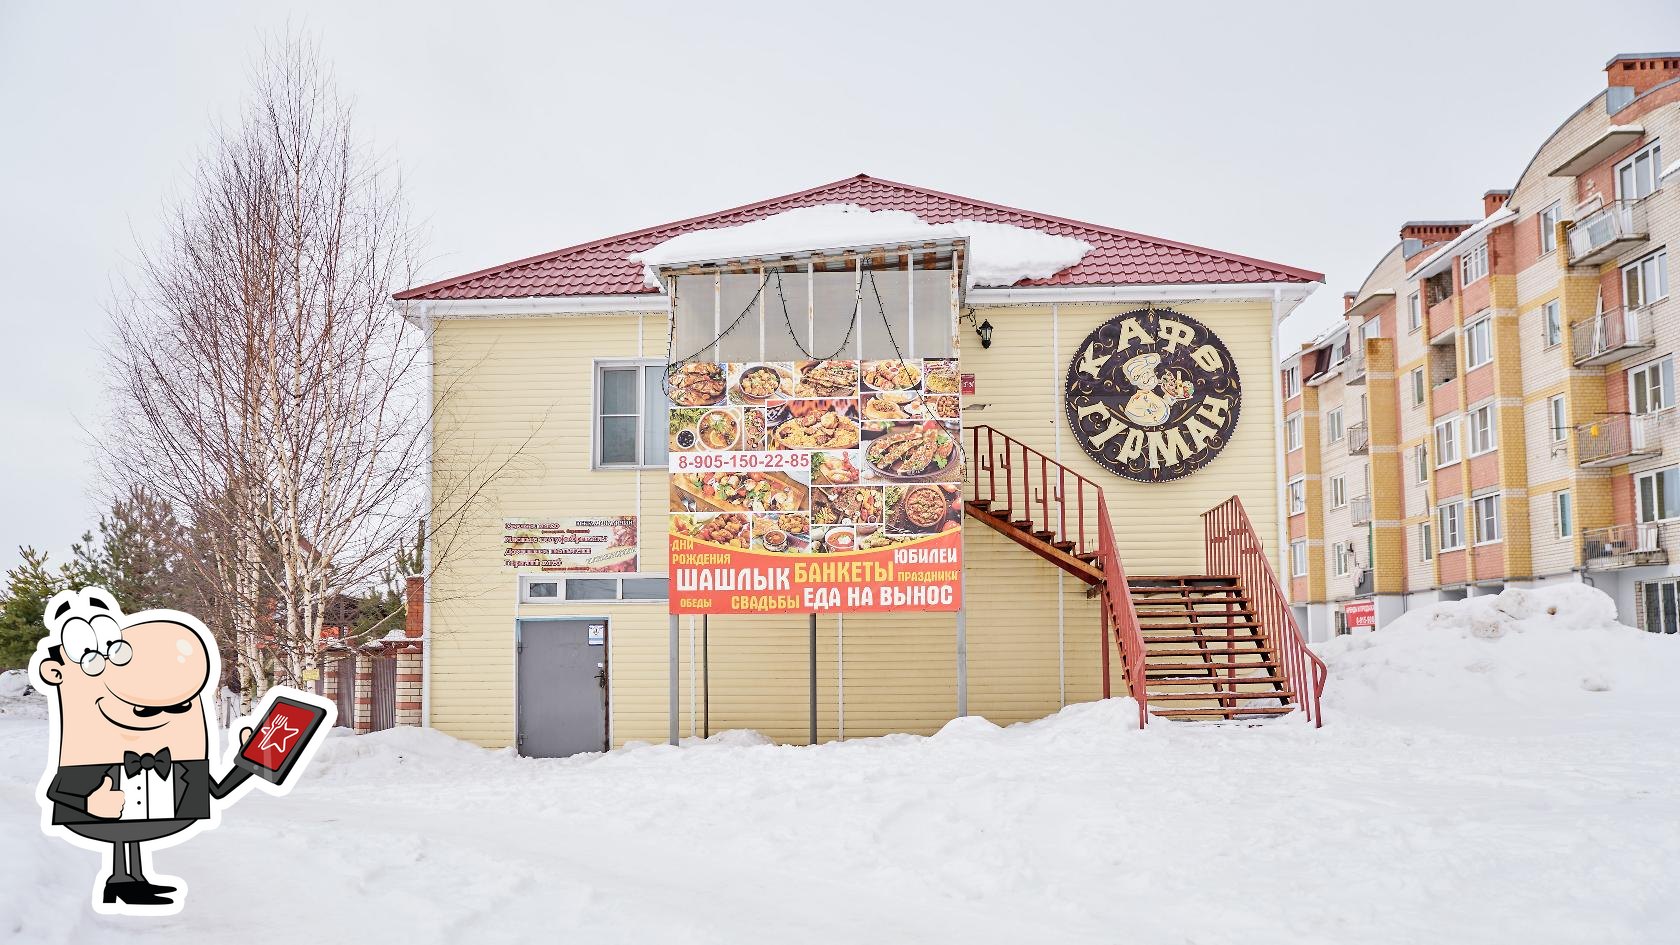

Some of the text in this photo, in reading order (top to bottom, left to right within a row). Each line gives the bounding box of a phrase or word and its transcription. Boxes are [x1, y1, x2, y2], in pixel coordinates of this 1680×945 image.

[1078, 317, 1225, 379] КАФЕ
[1077, 394, 1229, 469] ГУРМАН
[678, 453, 810, 469] 8-905-150-22-85
[671, 539, 694, 552] ДНИ
[672, 553, 731, 565] РОЖДЕНИЯ
[676, 567, 791, 592] ШАШЛЫК
[794, 561, 894, 583] БАНКЕТЫ
[897, 570, 959, 583] ПРАЗДНИКИ
[680, 598, 712, 609] ОБЕДЫ
[731, 595, 800, 611] СВАДЬБЫ
[803, 585, 953, 610] ЕДА НА ВЫНОС
